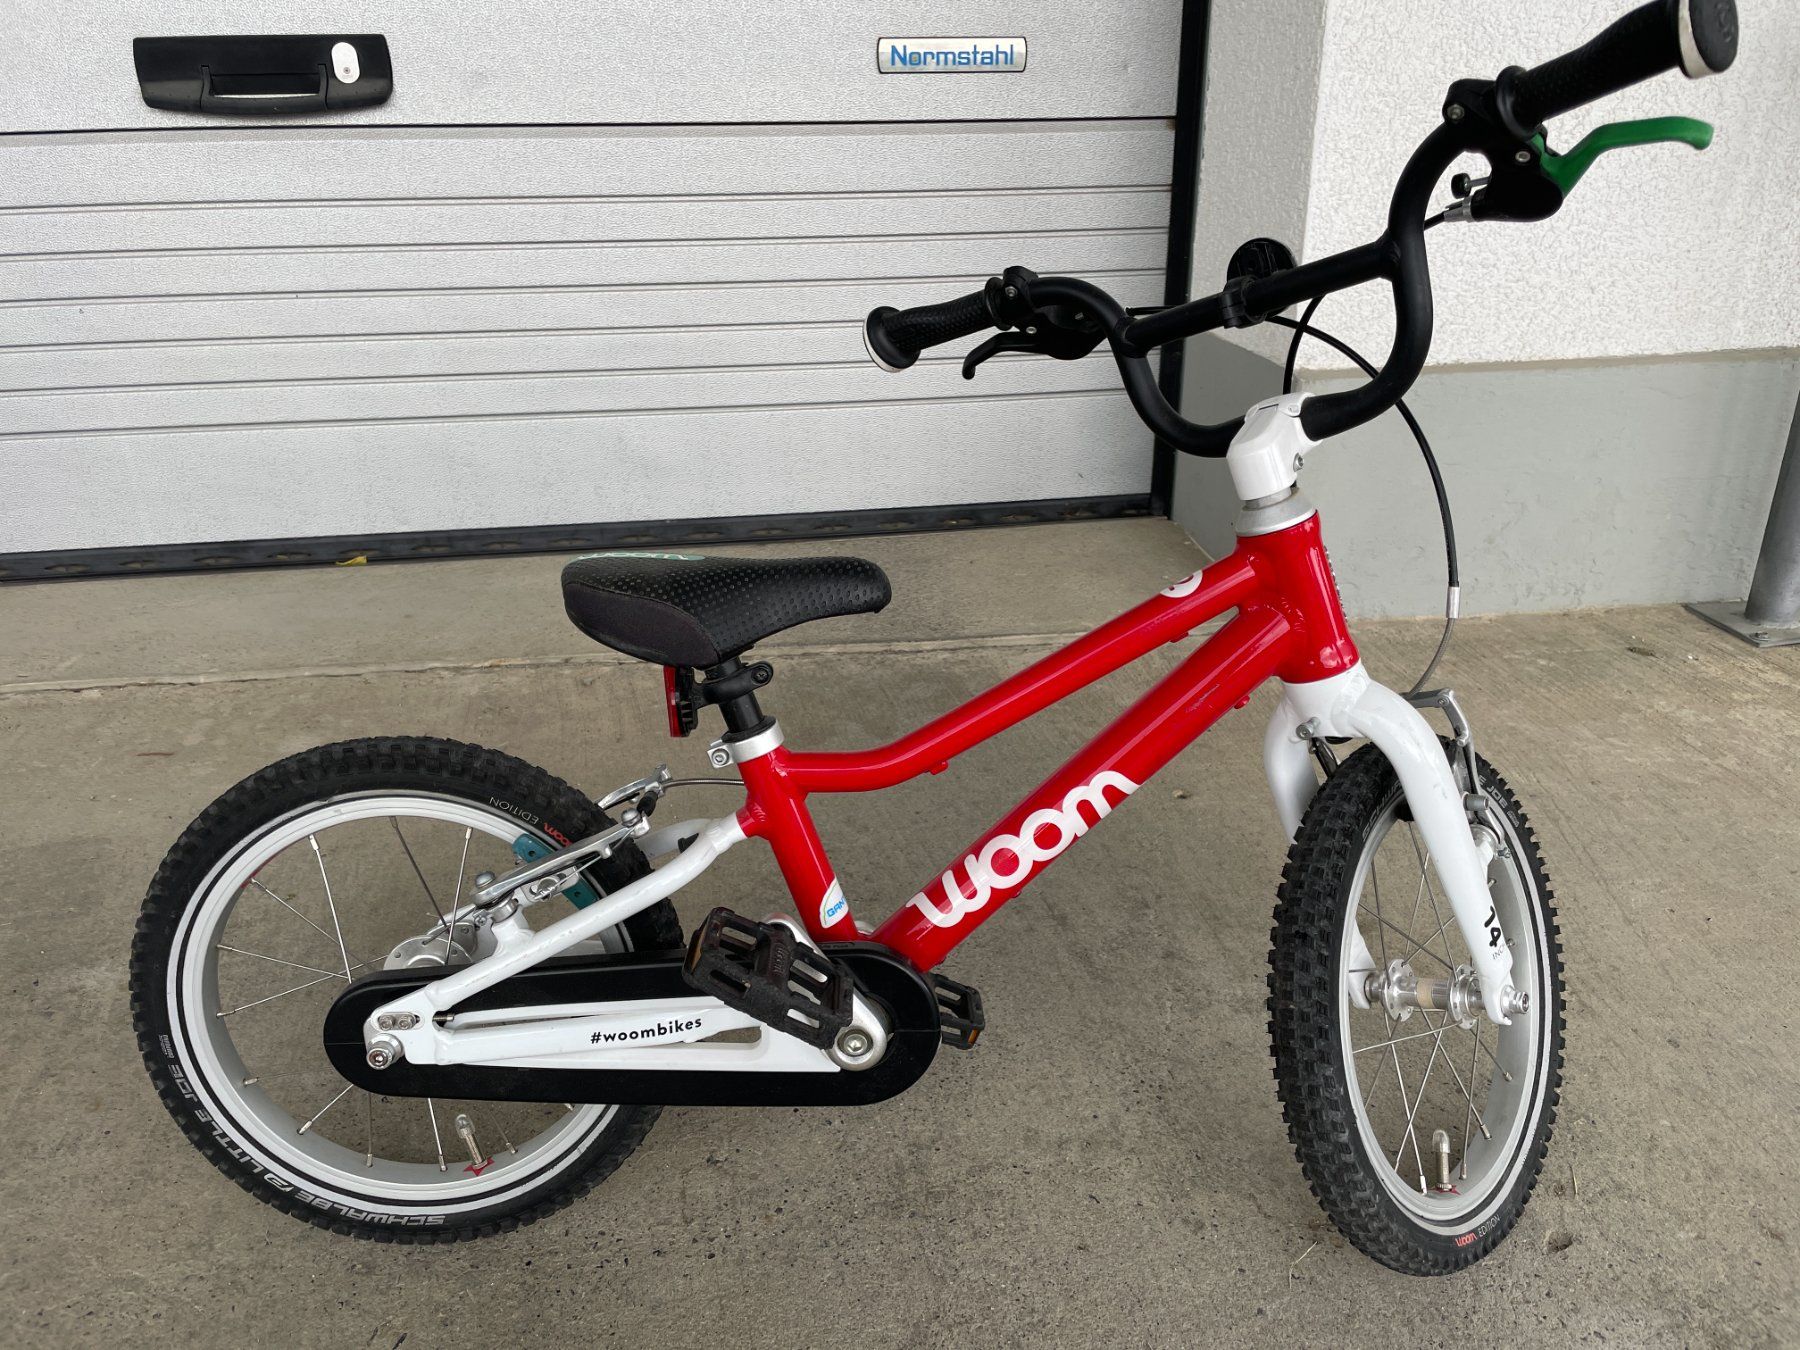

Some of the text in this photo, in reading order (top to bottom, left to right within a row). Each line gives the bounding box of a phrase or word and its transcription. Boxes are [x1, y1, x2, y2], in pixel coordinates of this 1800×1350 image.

[890, 44, 1014, 66] Normstahl
[489, 796, 540, 825] EDITION
[905, 770, 1141, 928] woom
[1484, 905, 1501, 947] 14
[590, 1018, 702, 1044] #woombikes
[168, 1064, 446, 1226] SCHWALBE LITTLE JOE
[1478, 1213, 1501, 1238] EDITION
